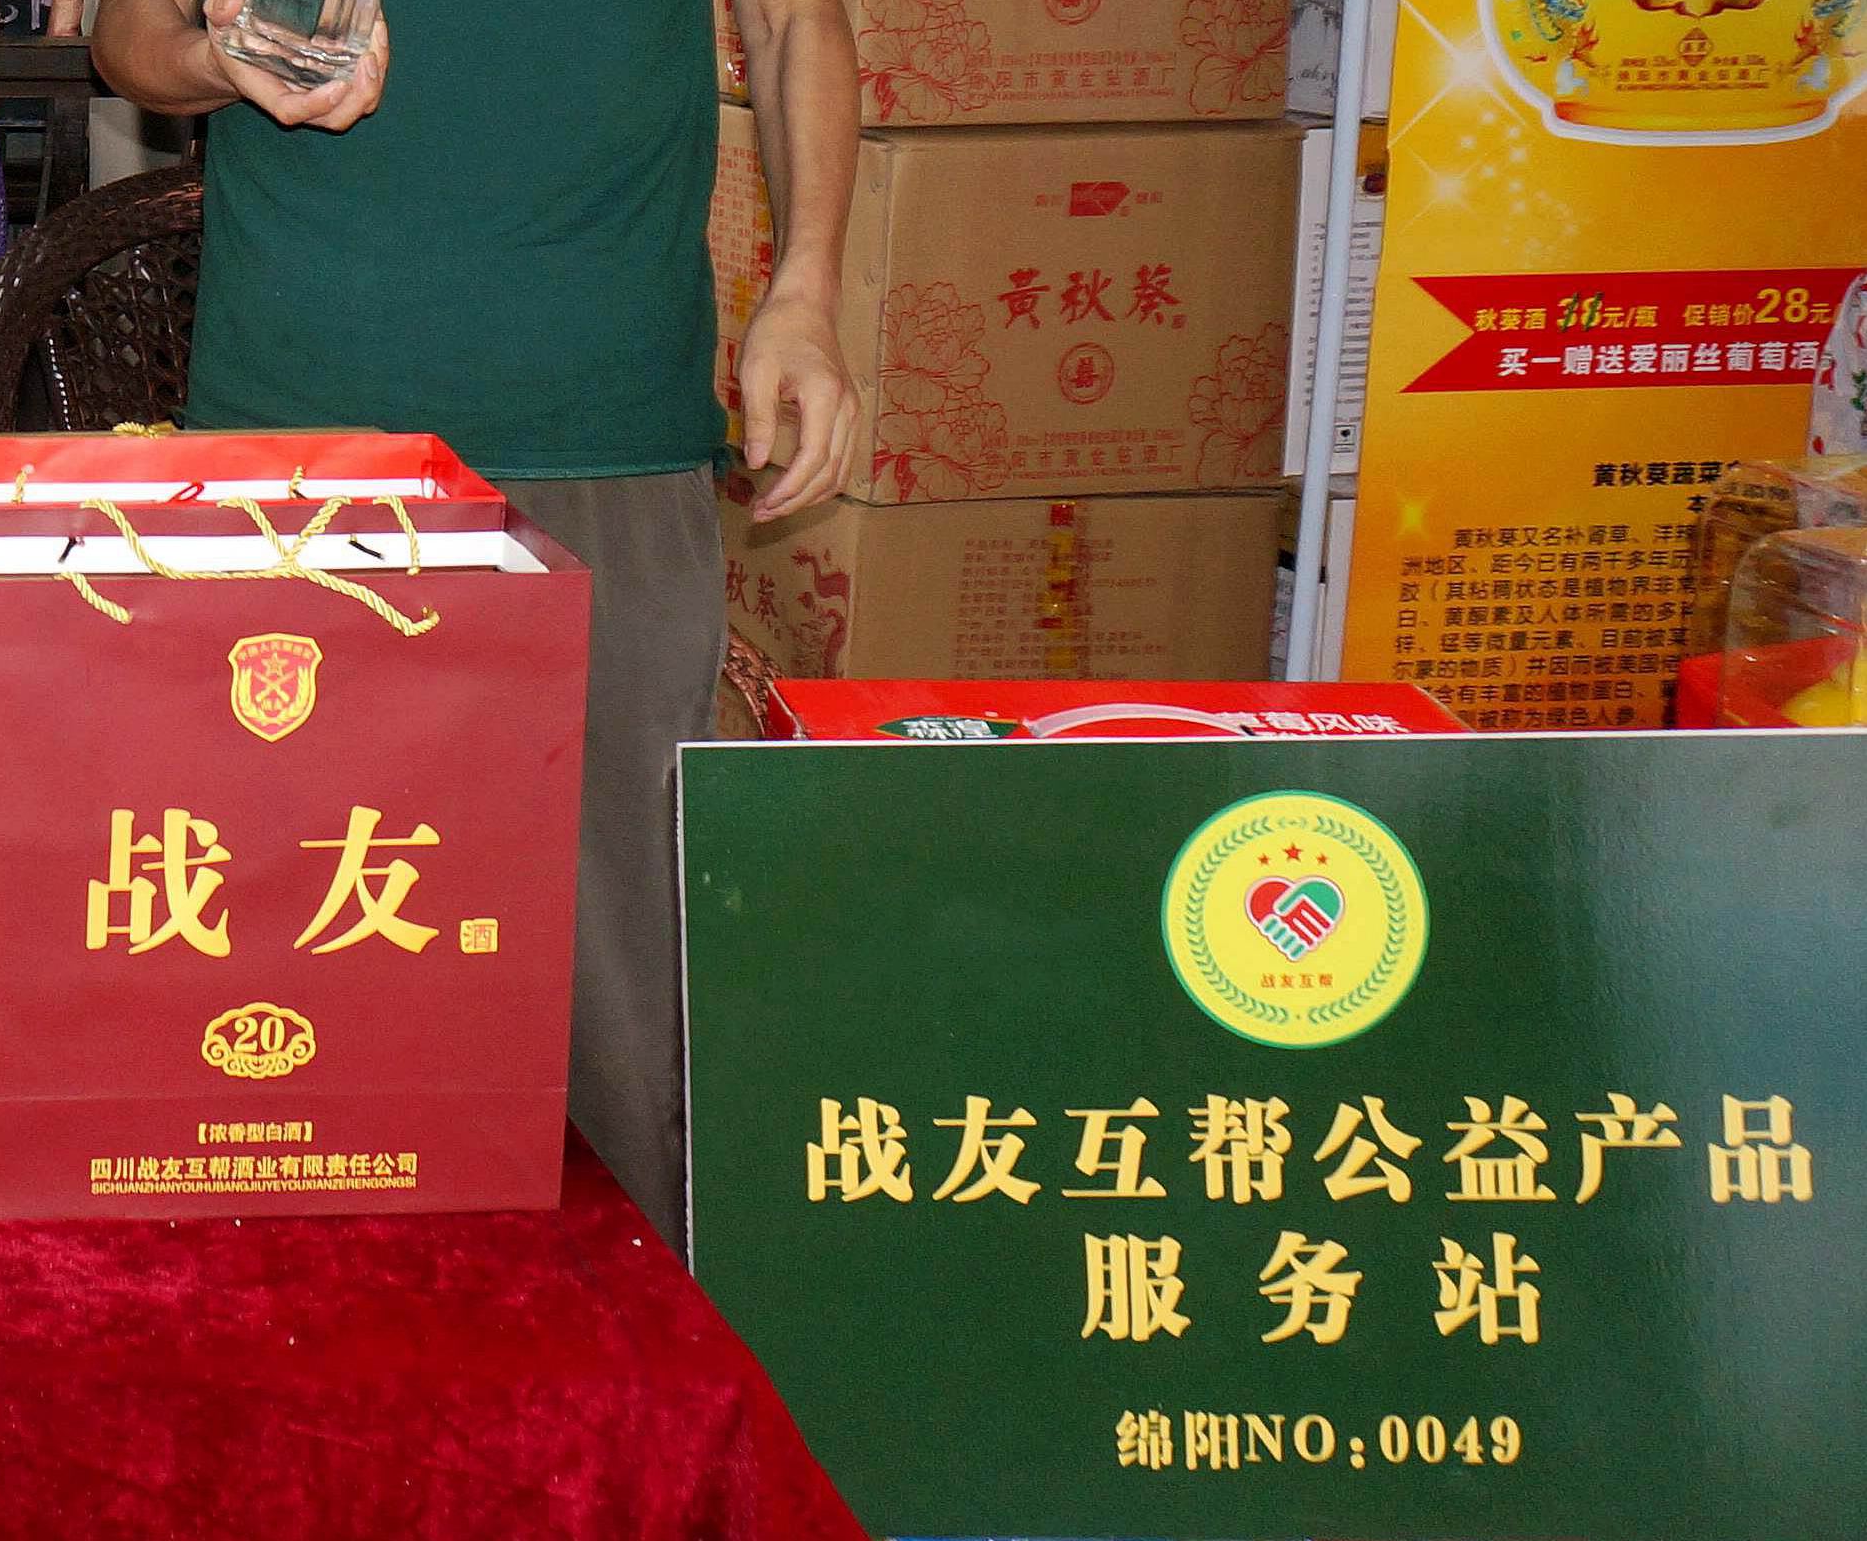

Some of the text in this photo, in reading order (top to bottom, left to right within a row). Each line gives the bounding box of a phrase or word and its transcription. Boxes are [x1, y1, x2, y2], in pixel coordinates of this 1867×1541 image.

[1592, 460, 1740, 488] 黄秋葵蔬菜
[85, 805, 442, 956] 战友
[233, 1014, 285, 1054] 20
[89, 1152, 419, 1181] 四川战友互帮酒业有限责任公司
[804, 1091, 1815, 1205] 战友互帮公益产品
[1080, 1231, 1544, 1346] 服务站
